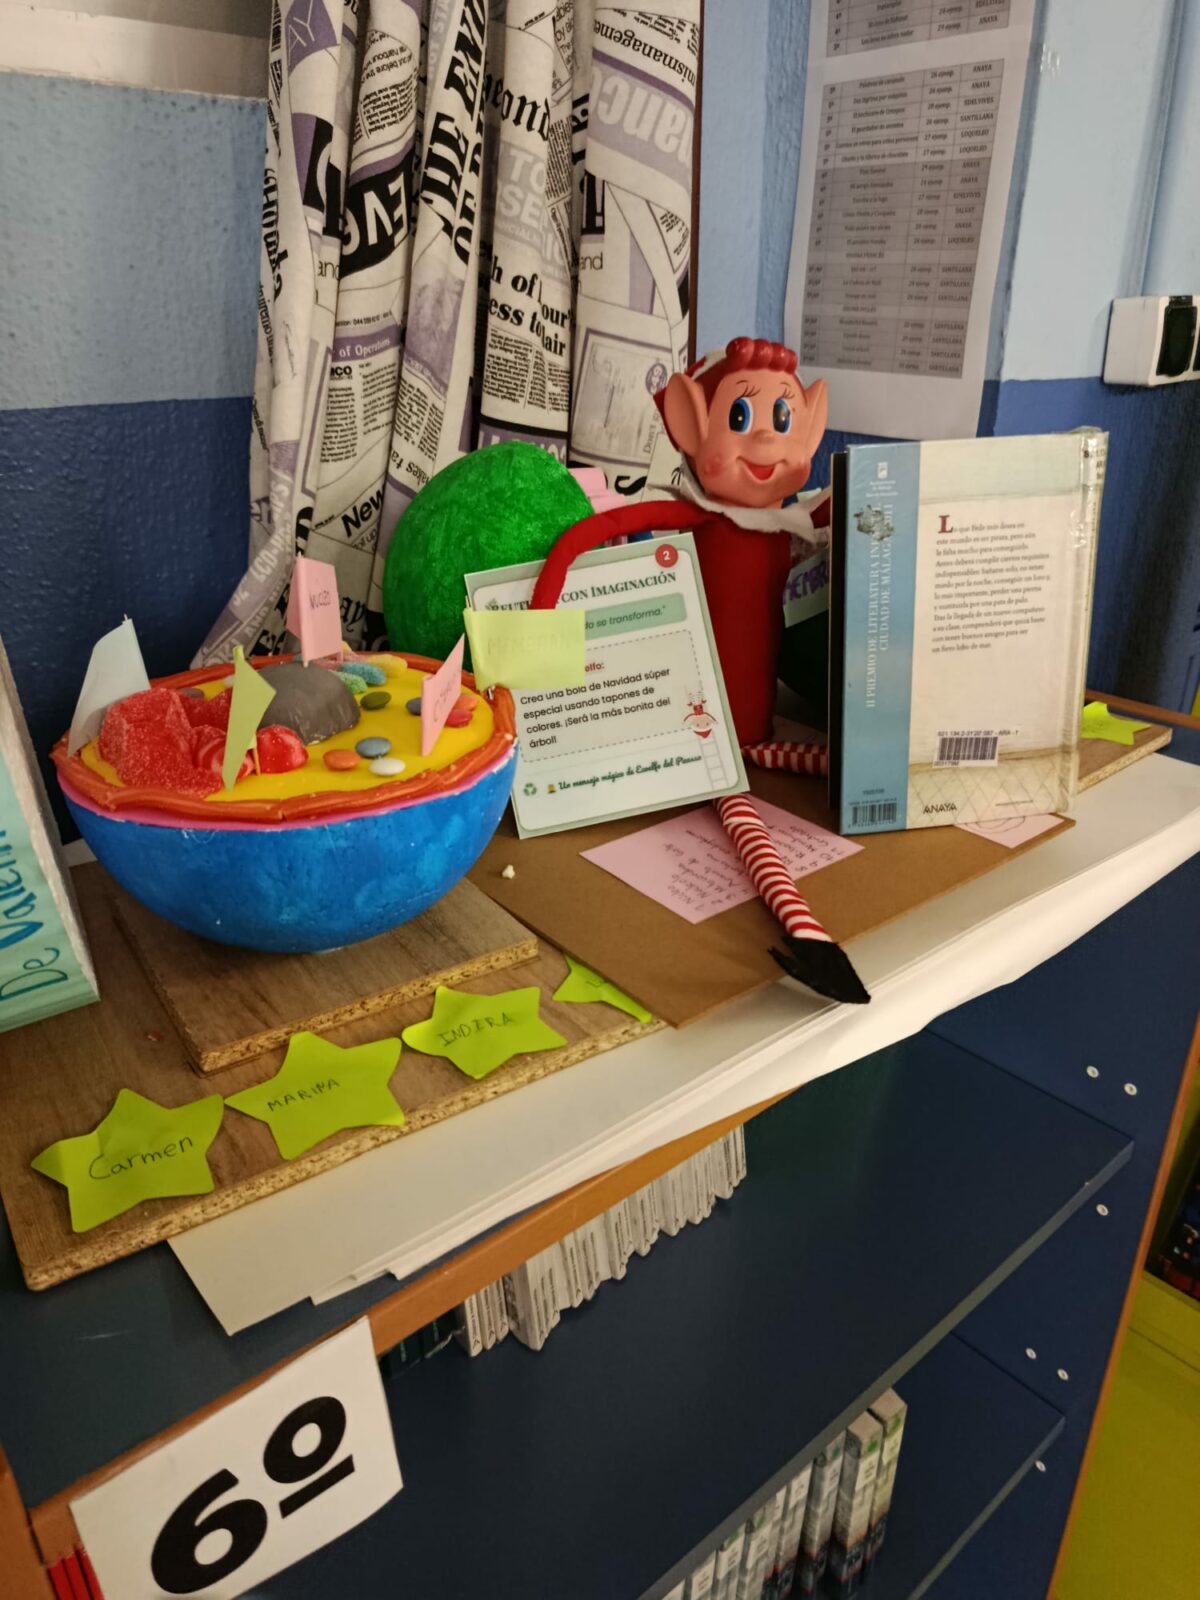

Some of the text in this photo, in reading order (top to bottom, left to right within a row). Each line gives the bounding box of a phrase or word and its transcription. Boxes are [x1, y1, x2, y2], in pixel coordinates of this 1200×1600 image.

[511, 273, 538, 297] of
[663, 552, 670, 560] 2
[561, 590, 589, 604] CON
[868, 561, 880, 634] LITERATURA
[880, 588, 891, 604] DE
[596, 619, 607, 627] se
[879, 607, 890, 651] CIUDAD
[868, 636, 879, 652] DE
[520, 692, 544, 705] Crea
[547, 689, 564, 700] una
[589, 682, 601, 692] de
[603, 673, 642, 689] Navidad
[644, 668, 670, 684] súper
[866, 653, 877, 698] PREMIO
[523, 686, 655, 720] especial usando tapones de
[526, 697, 671, 734] colores. ¡Será la más bonita del
[529, 735, 557, 749] árbol!
[559, 780, 571, 791] Un
[573, 773, 600, 789] mensaje
[601, 768, 625, 784] mágico
[626, 766, 635, 776] de
[663, 758, 674, 768] del
[923, 802, 957, 815] ANAYA
[0, 947, 69, 1000] De
[87, 1134, 195, 1181] Carmen
